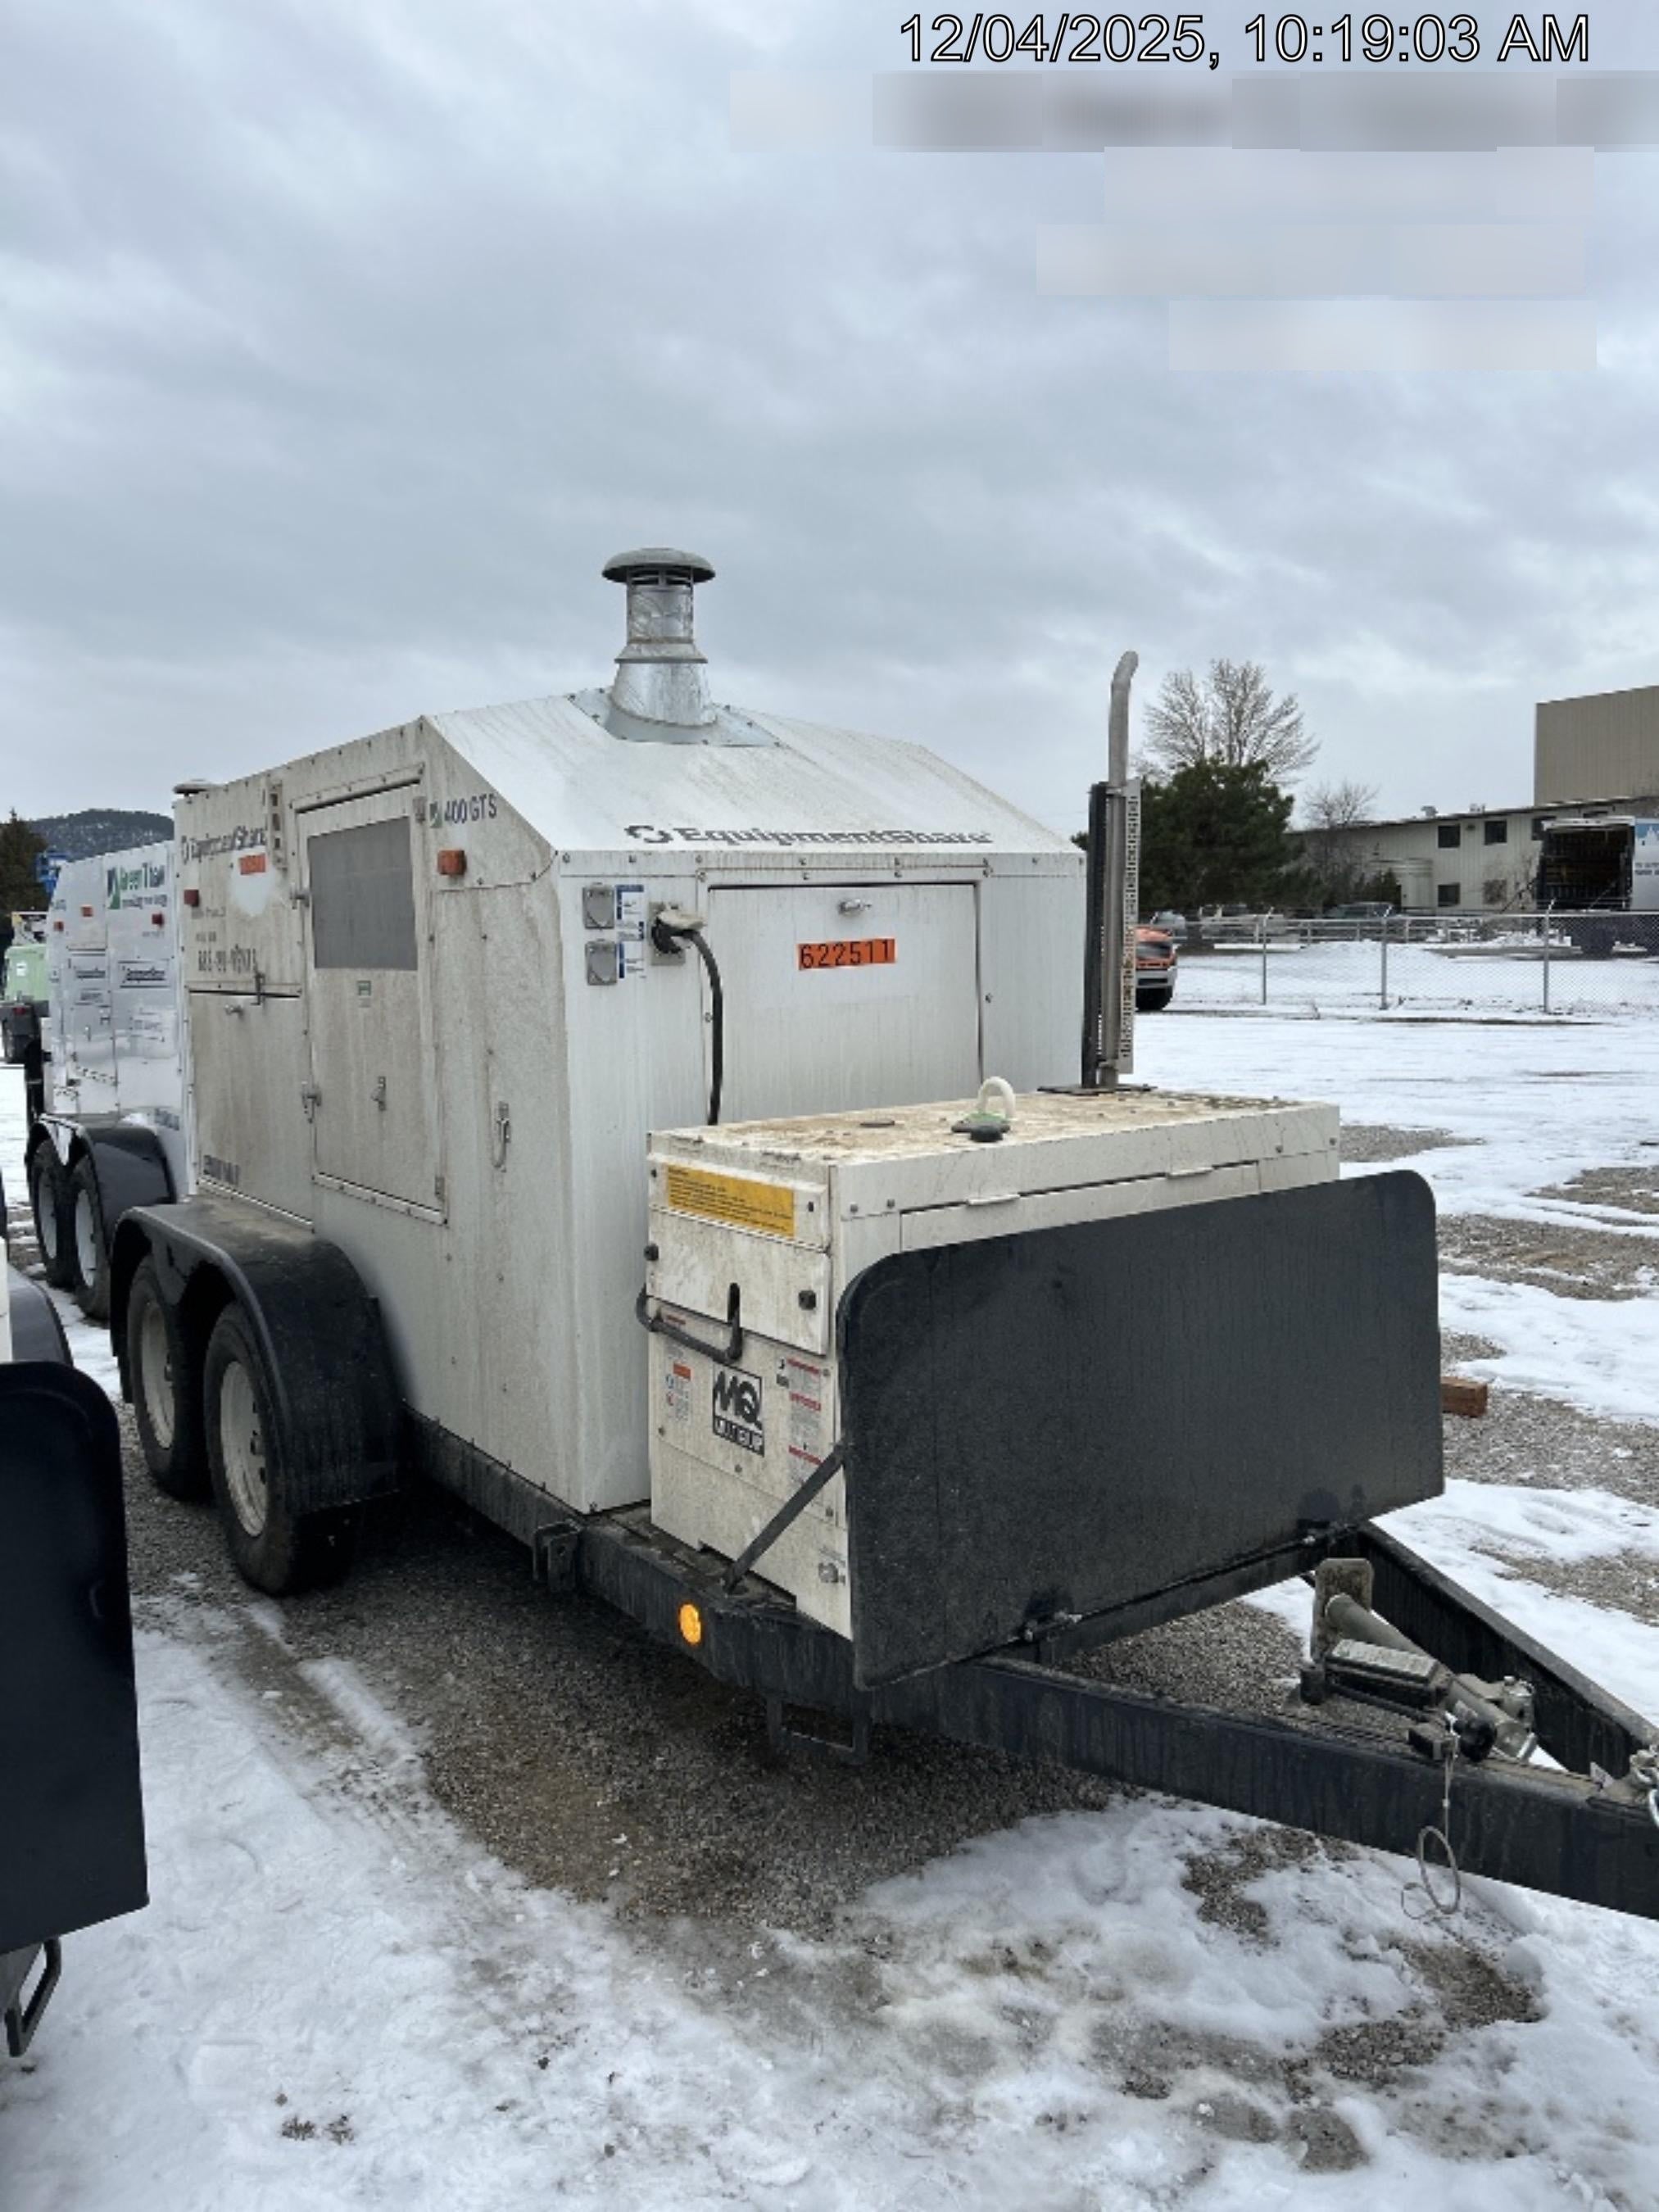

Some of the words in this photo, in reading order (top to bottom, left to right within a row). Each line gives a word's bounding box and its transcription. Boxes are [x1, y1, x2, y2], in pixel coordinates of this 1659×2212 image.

[445, 798, 468, 824] 400
[470, 793, 497, 822] GTS
[673, 827, 993, 846] EquipmentShare
[800, 939, 889, 969] 622511
